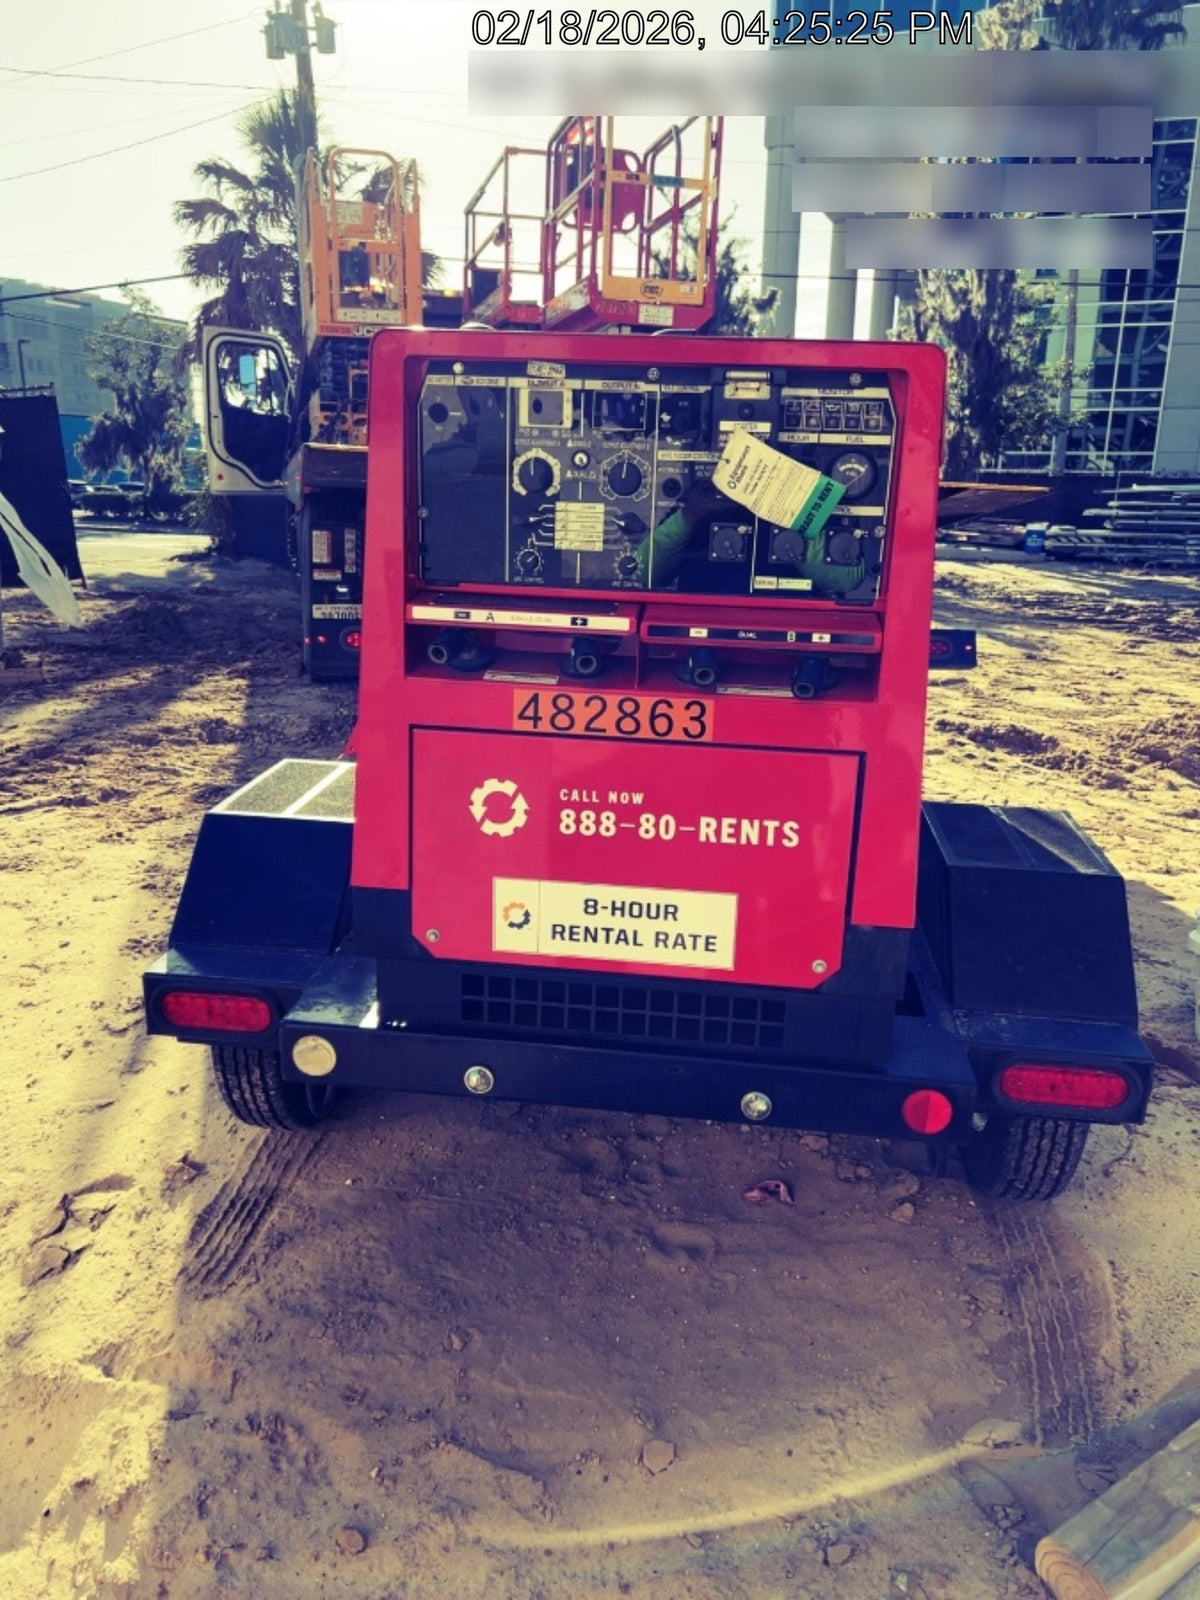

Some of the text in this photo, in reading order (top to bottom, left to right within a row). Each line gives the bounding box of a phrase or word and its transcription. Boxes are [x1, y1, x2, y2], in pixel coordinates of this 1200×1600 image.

[786, 434, 810, 442] HOUR
[817, 480, 835, 503] RENT
[485, 611, 495, 622] A
[517, 692, 709, 740] 482863
[559, 788, 645, 805] CALL NOW
[559, 808, 800, 848] 888-80-RENTS
[583, 897, 680, 922] 8-HOUR
[551, 923, 718, 953] RENTAL RATE
